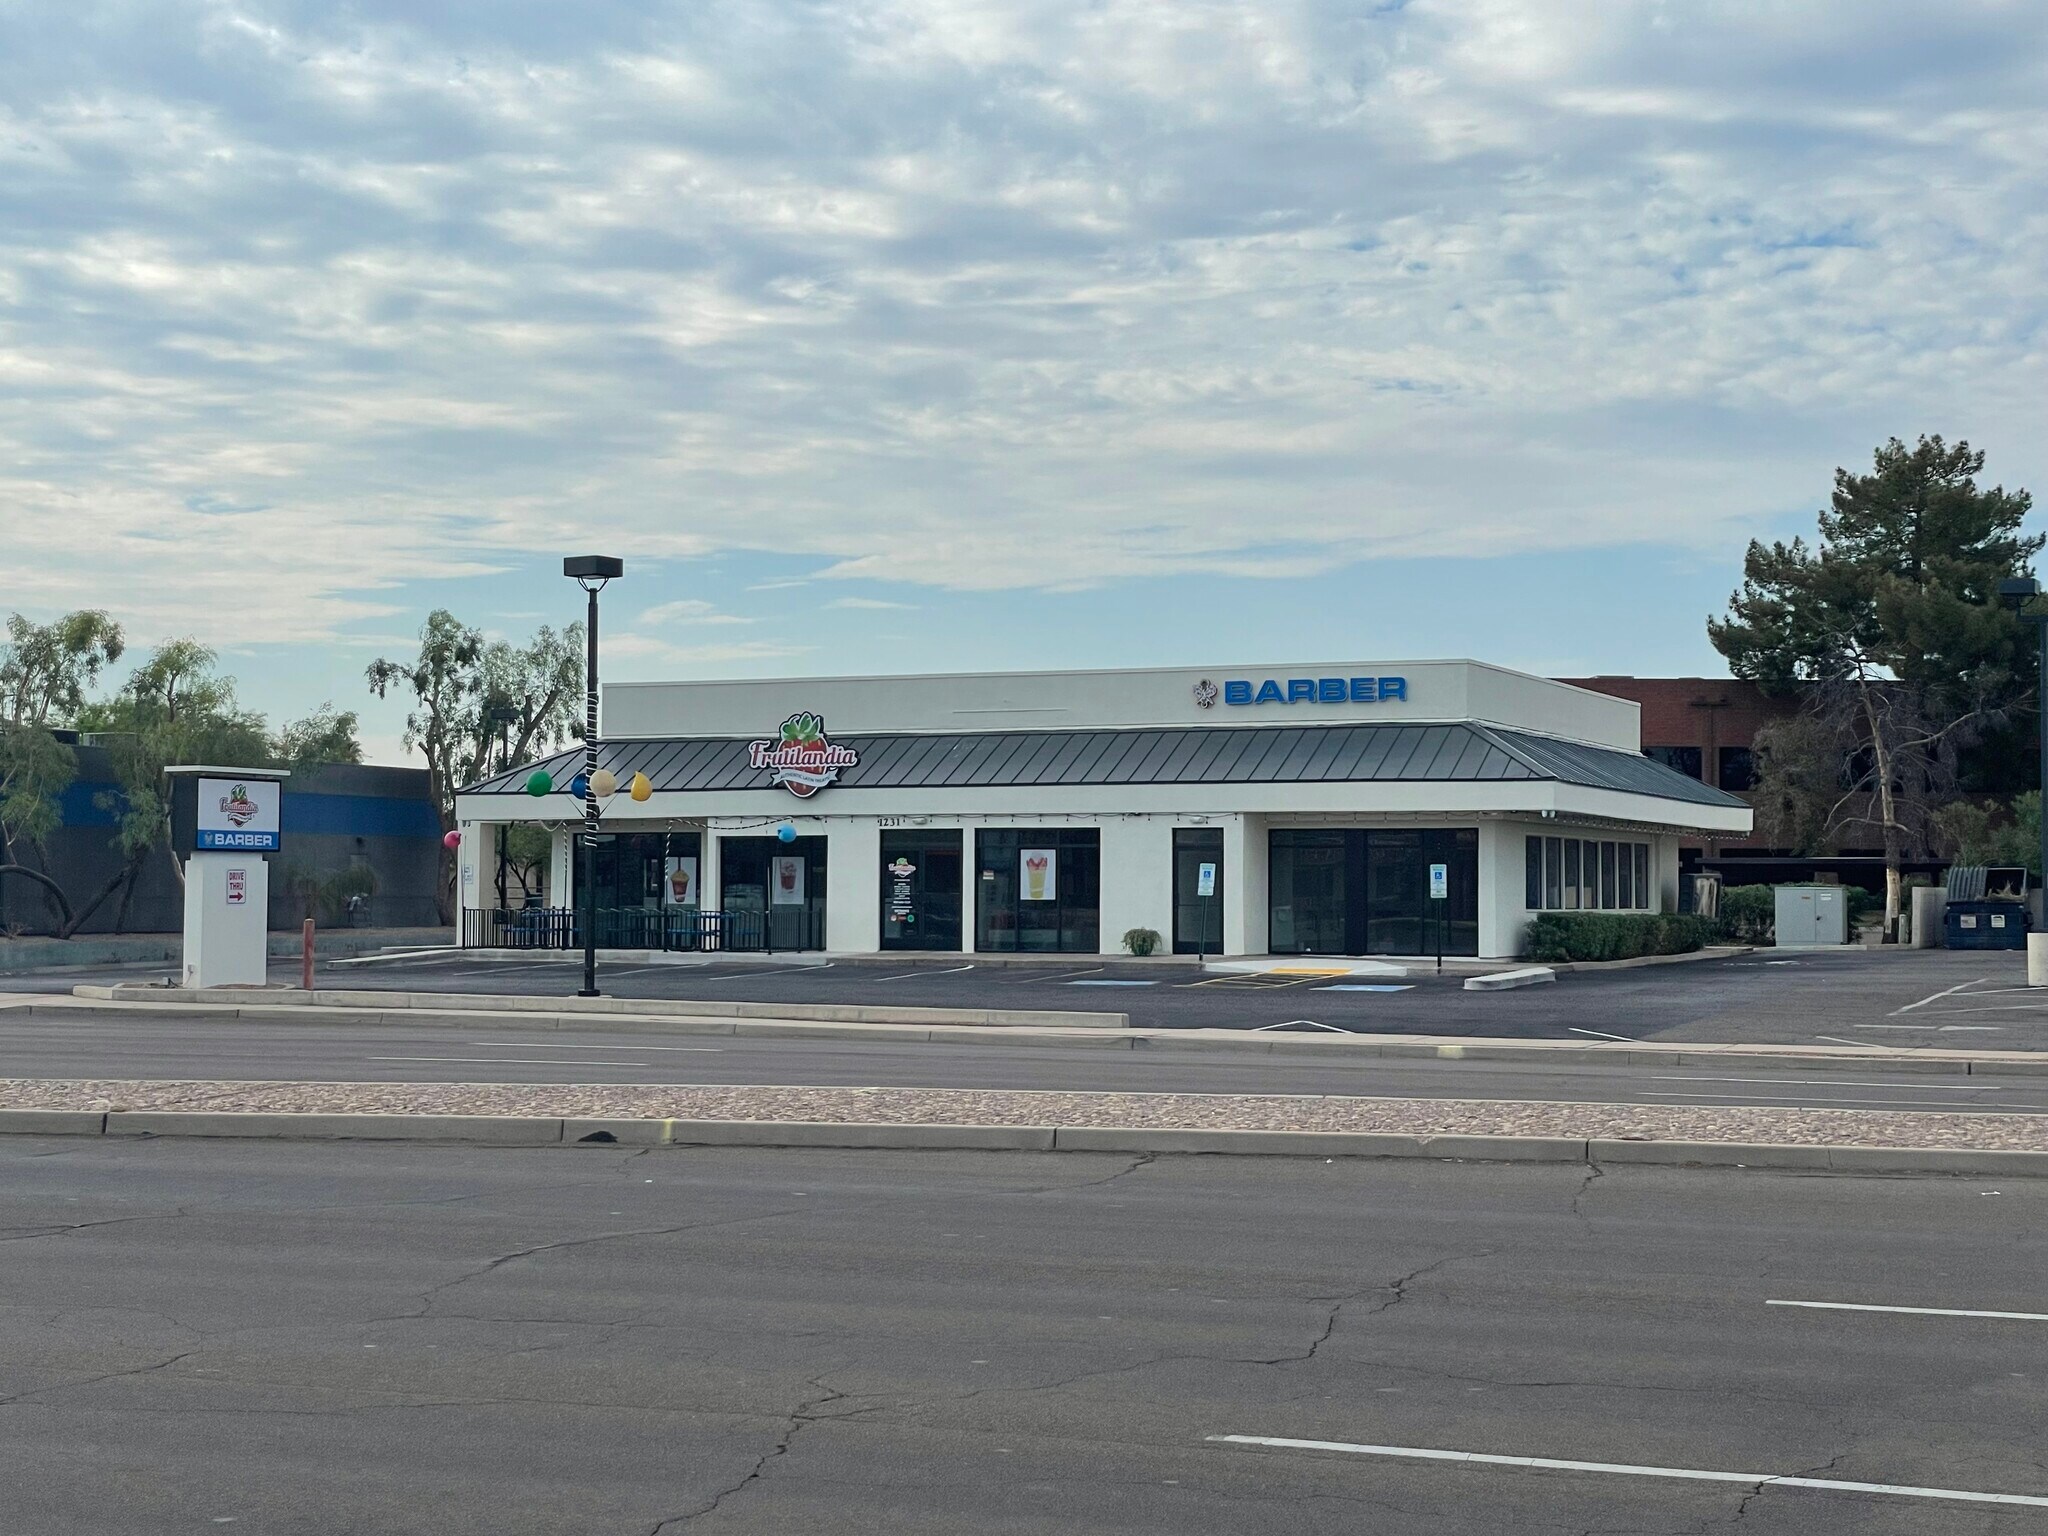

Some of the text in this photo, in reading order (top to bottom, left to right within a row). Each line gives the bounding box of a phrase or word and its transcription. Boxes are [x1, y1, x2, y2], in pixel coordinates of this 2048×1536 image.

[1224, 677, 1408, 704] BARBER
[749, 741, 858, 767] Frutilandia
[880, 818, 900, 826] 1231
[214, 833, 272, 846] BARBER
[229, 872, 244, 880] DRIVE
[230, 882, 243, 890] THRU
